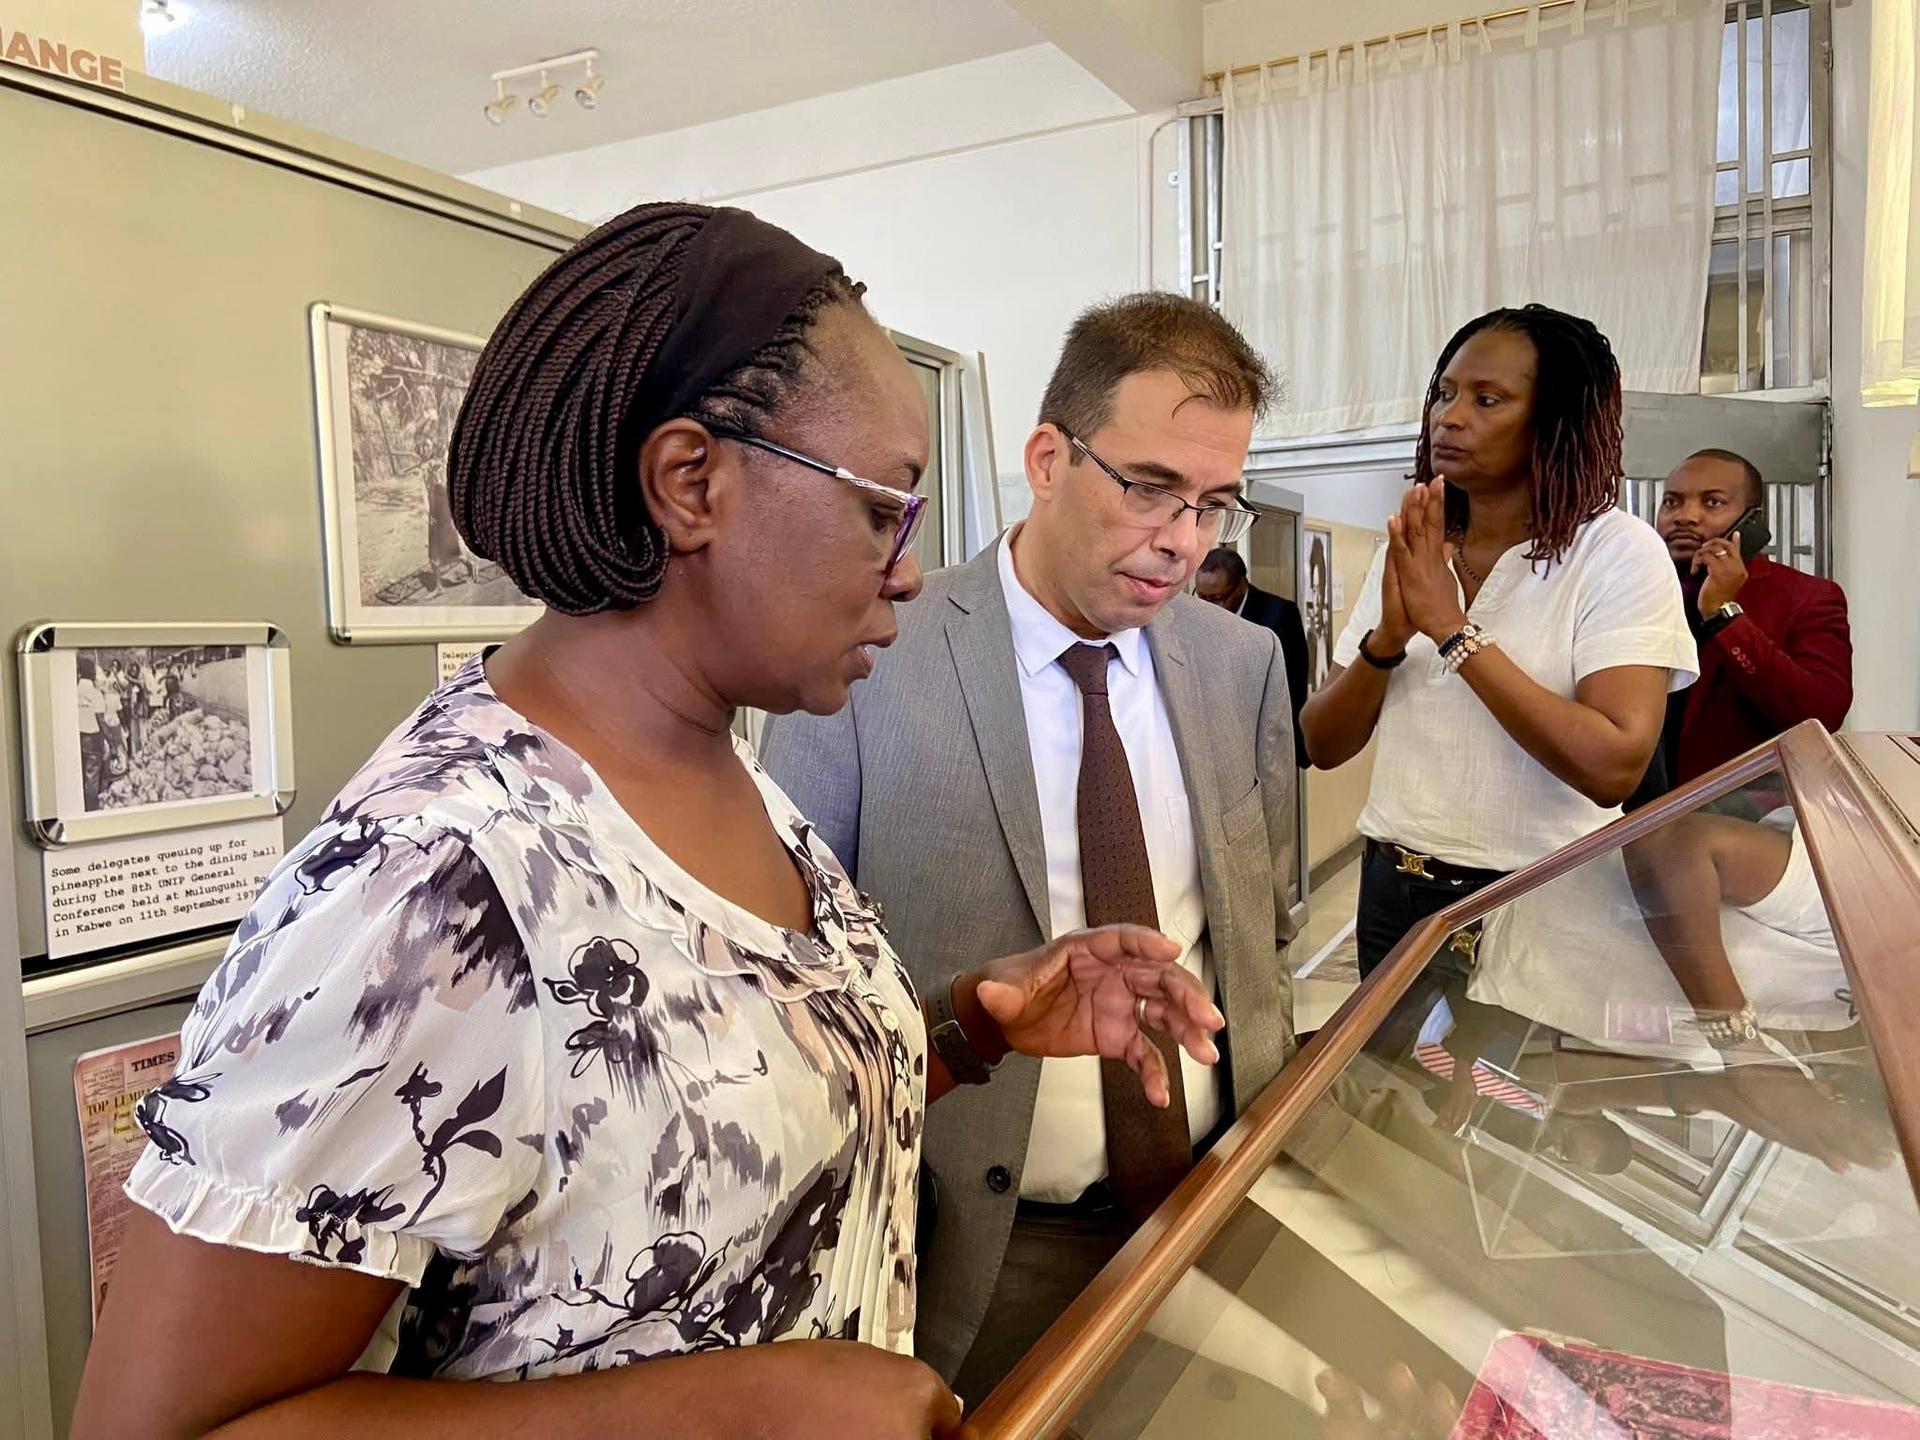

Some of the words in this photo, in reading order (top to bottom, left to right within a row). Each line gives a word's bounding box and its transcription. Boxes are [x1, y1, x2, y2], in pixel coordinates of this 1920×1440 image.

[52, 867, 81, 878] Some
[88, 856, 151, 871] delegates
[157, 847, 203, 862] queuing
[209, 844, 222, 853] up
[229, 839, 247, 848] for
[52, 874, 124, 894] pineapples
[131, 868, 159, 879] next
[165, 865, 178, 873] to
[185, 860, 204, 870] the
[210, 854, 247, 865] dining
[253, 847, 276, 857] hall
[52, 893, 97, 908] during
[105, 888, 124, 898] the
[132, 882, 152, 893] 8th
[159, 876, 185, 888] UNIP
[191, 868, 236, 883] General
[53, 902, 125, 923] Conference
[132, 895, 160, 908] held
[166, 891, 179, 901] at
[186, 879, 248, 899] Mulungushi
[54, 927, 70, 937] in
[76, 921, 112, 934] Kabwe
[119, 916, 133, 925] on
[140, 908, 167, 921] 11th
[173, 896, 230, 914] September
[131, 1051, 175, 1072] TIMES
[86, 1100, 109, 1117] TOP
